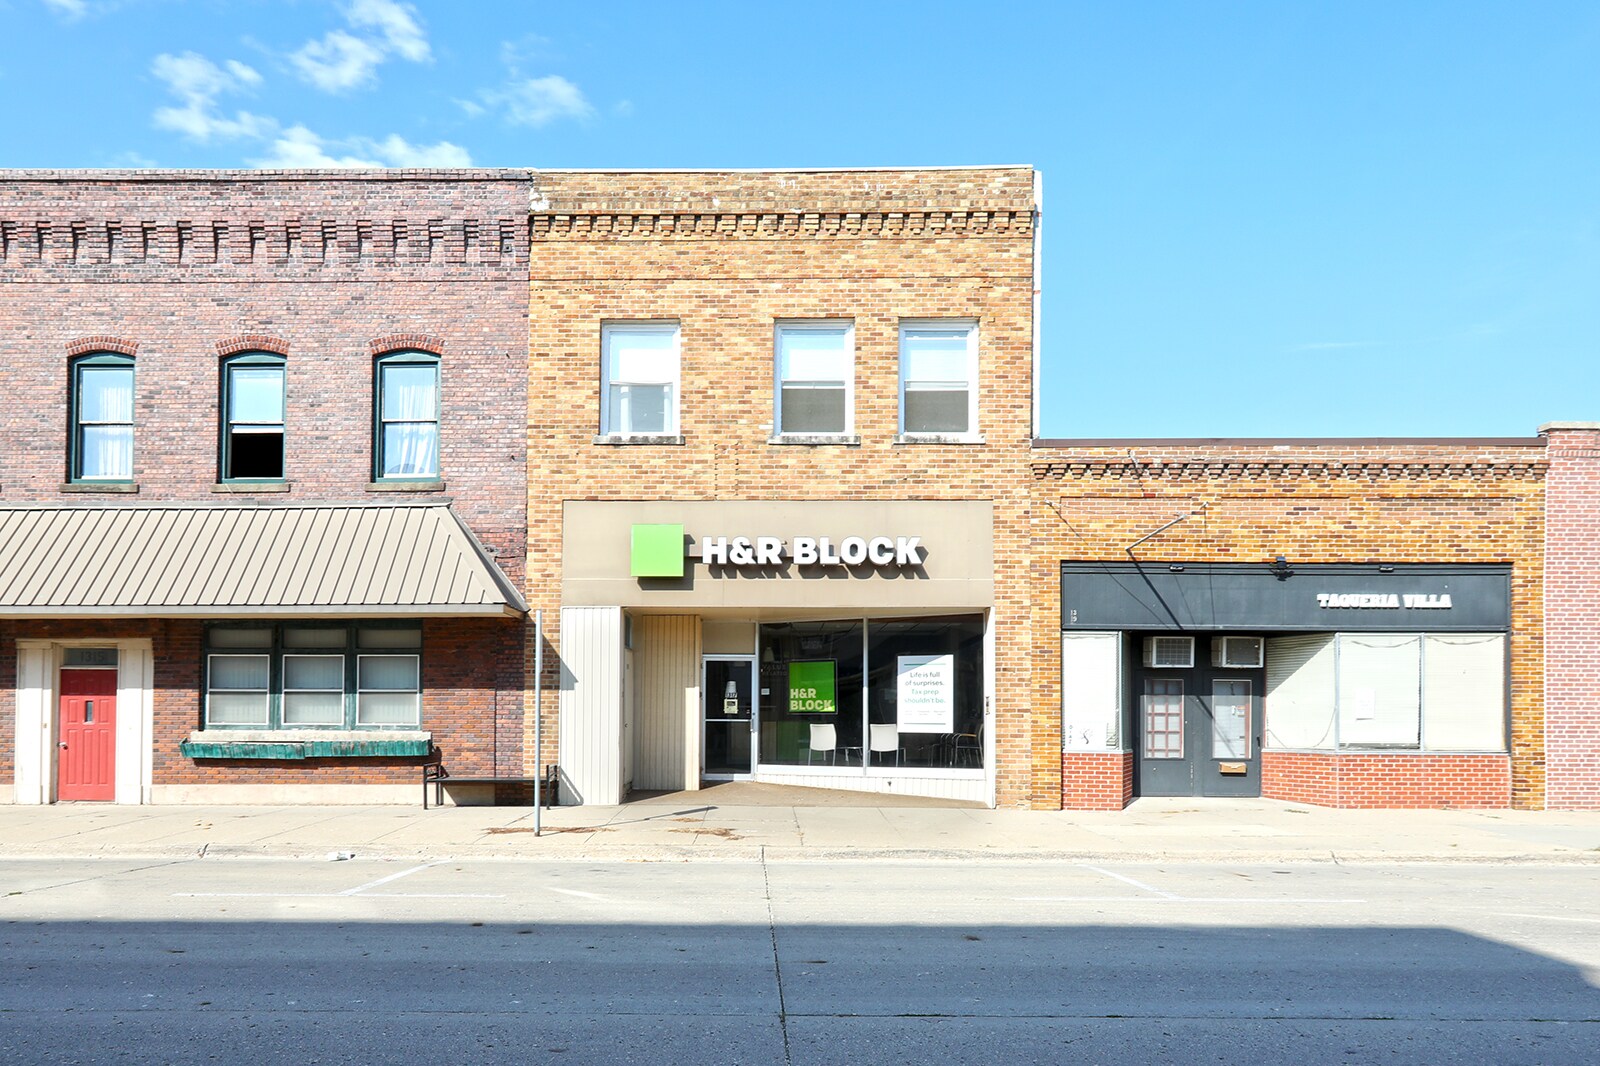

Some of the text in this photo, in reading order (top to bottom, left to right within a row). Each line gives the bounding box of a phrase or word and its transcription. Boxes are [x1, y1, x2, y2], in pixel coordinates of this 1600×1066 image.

[702, 536, 922, 565] H&R BLOCK
[1316, 593, 1452, 609] TAQUERIA VILLA
[790, 688, 817, 699] H&R
[790, 700, 833, 711] BLOCK
